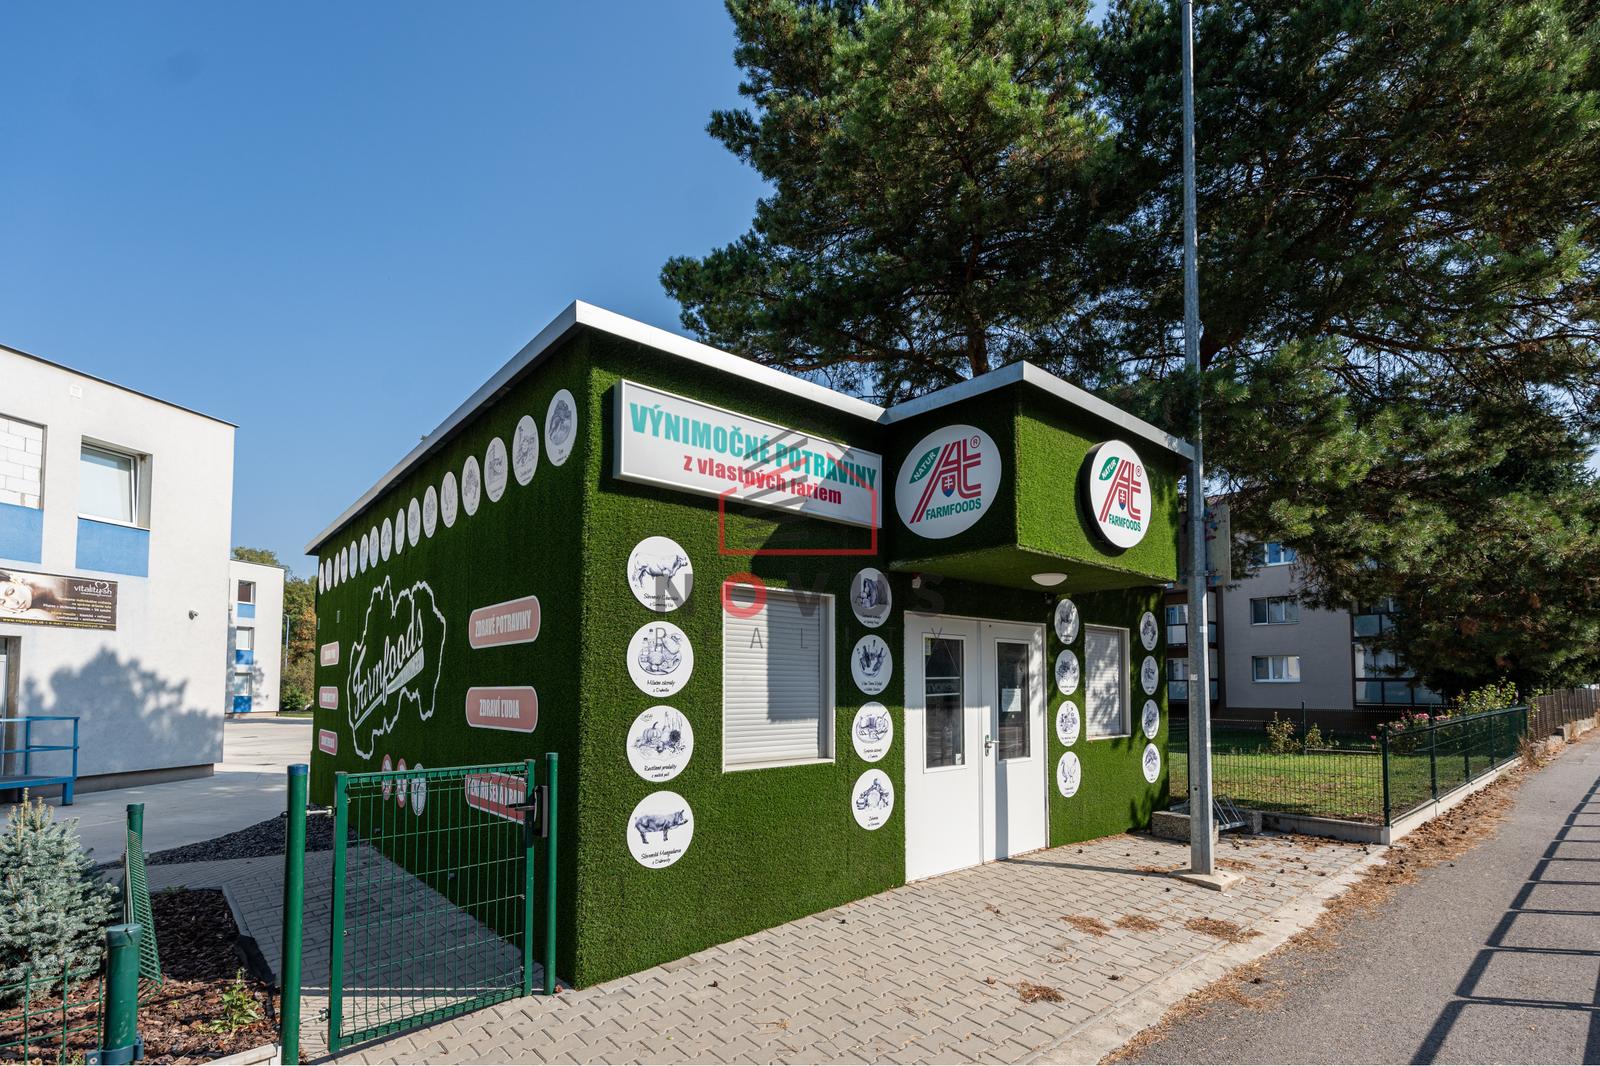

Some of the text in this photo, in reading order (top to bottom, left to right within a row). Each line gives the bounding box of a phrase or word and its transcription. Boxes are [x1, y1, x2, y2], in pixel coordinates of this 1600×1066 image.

[629, 402, 878, 489] VÝNIMOČNÉ POTRAVINY
[913, 451, 937, 481] NATUR
[1101, 459, 1118, 480] NATUR
[683, 455, 842, 505] z vlastných fariem
[925, 498, 982, 521] FARMFOODS
[1108, 512, 1141, 532] FARMFOODS
[495, 609, 532, 634] POTRAVINY
[352, 598, 424, 720] Farmfoods
